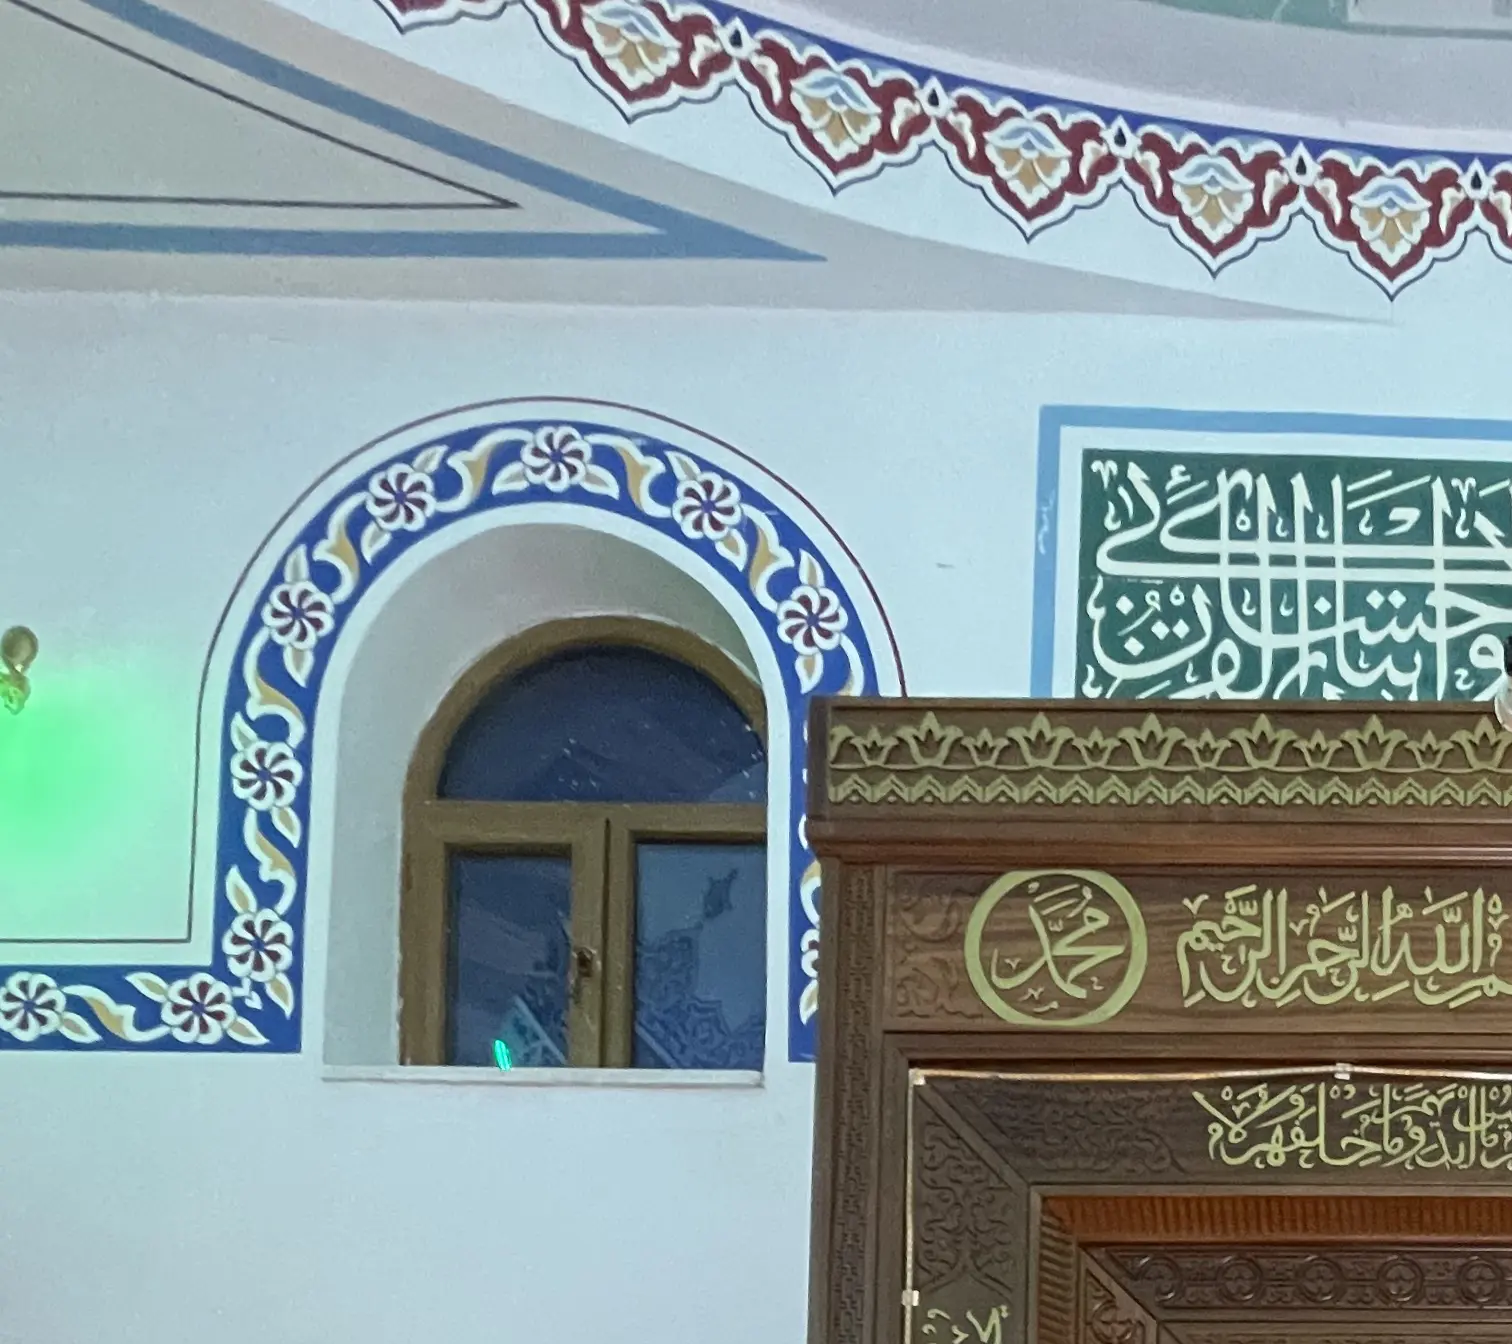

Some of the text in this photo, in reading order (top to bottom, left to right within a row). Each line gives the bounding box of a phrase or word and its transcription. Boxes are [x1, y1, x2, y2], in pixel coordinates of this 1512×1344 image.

[990, 893, 1127, 1003] محمد
[1176, 886, 1288, 1005] الرحيم
[1256, 885, 1394, 1006] الرحمن
[1371, 885, 1486, 980] الله
